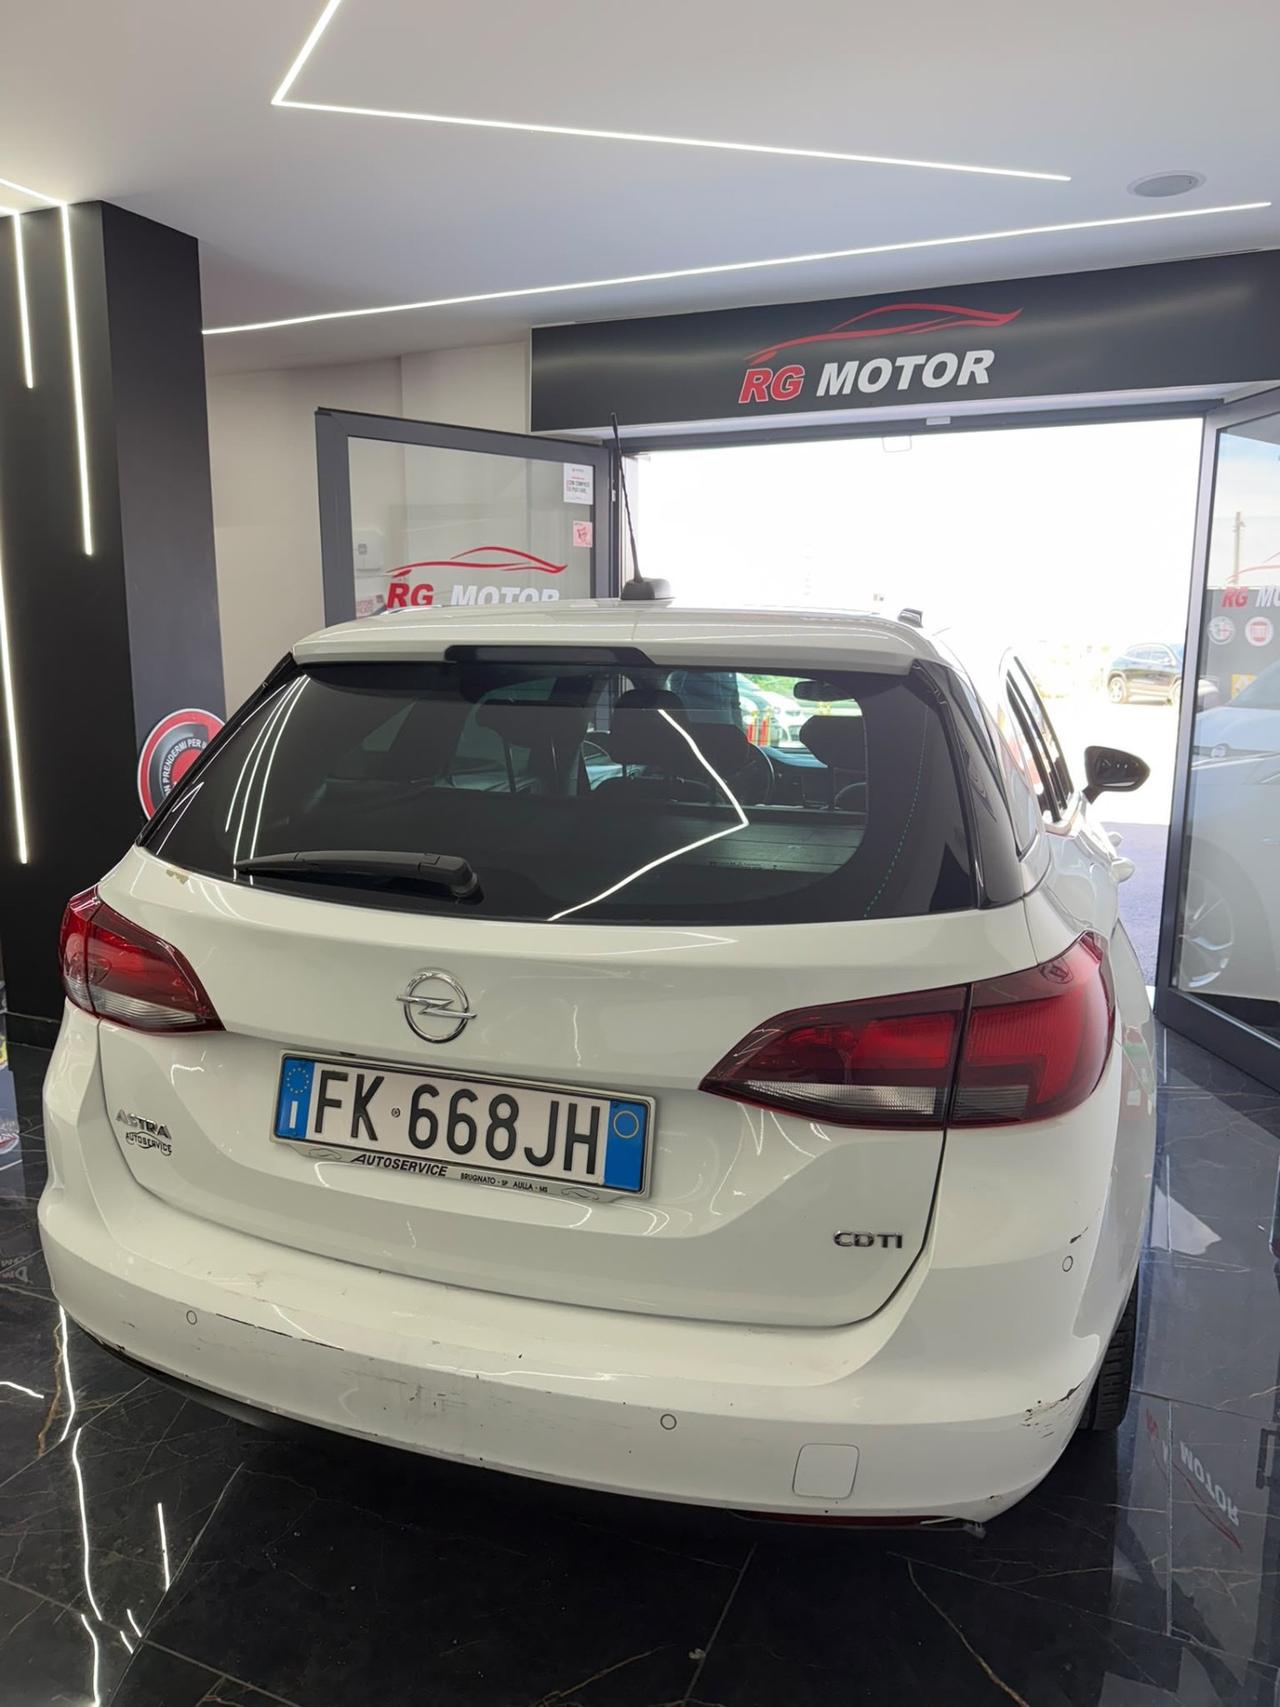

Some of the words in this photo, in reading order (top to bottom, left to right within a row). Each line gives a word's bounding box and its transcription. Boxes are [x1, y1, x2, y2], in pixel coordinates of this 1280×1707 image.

[738, 364, 805, 404] RG
[816, 350, 995, 397] MOTOR
[387, 582, 434, 609] RG
[1221, 586, 1248, 608] RG
[162, 740, 188, 784] PRENDERMI
[187, 738, 202, 748] PER
[116, 1108, 172, 1140] ASTRA
[315, 1069, 385, 1141] FK
[408, 1084, 600, 1175] 668JH
[351, 1153, 449, 1178] AUTOSERVICE
[460, 1172, 496, 1185] BRUGNATO
[513, 1181, 534, 1191] AULLA
[833, 1231, 903, 1249] CDTI
